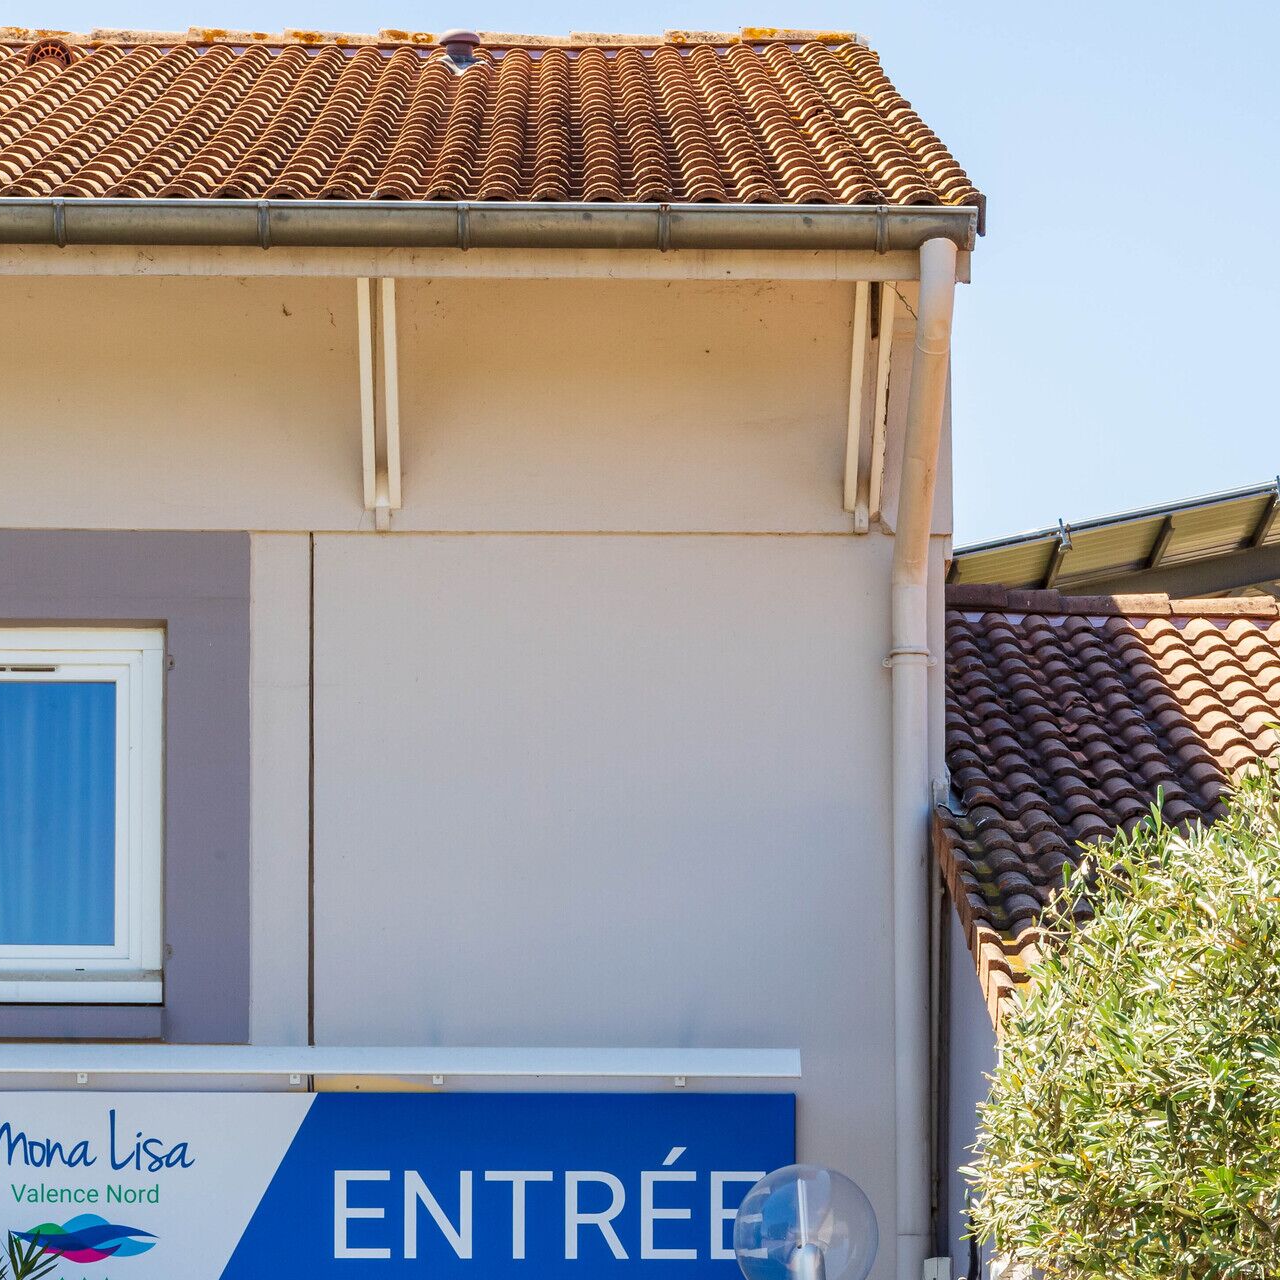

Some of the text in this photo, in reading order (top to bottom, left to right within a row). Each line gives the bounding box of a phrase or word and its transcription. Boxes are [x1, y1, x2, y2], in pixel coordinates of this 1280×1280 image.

[109, 1109, 196, 1173] Lisa
[10, 1183, 160, 1204] Valence Nord
[332, 1146, 768, 1260] ENTRÉE
